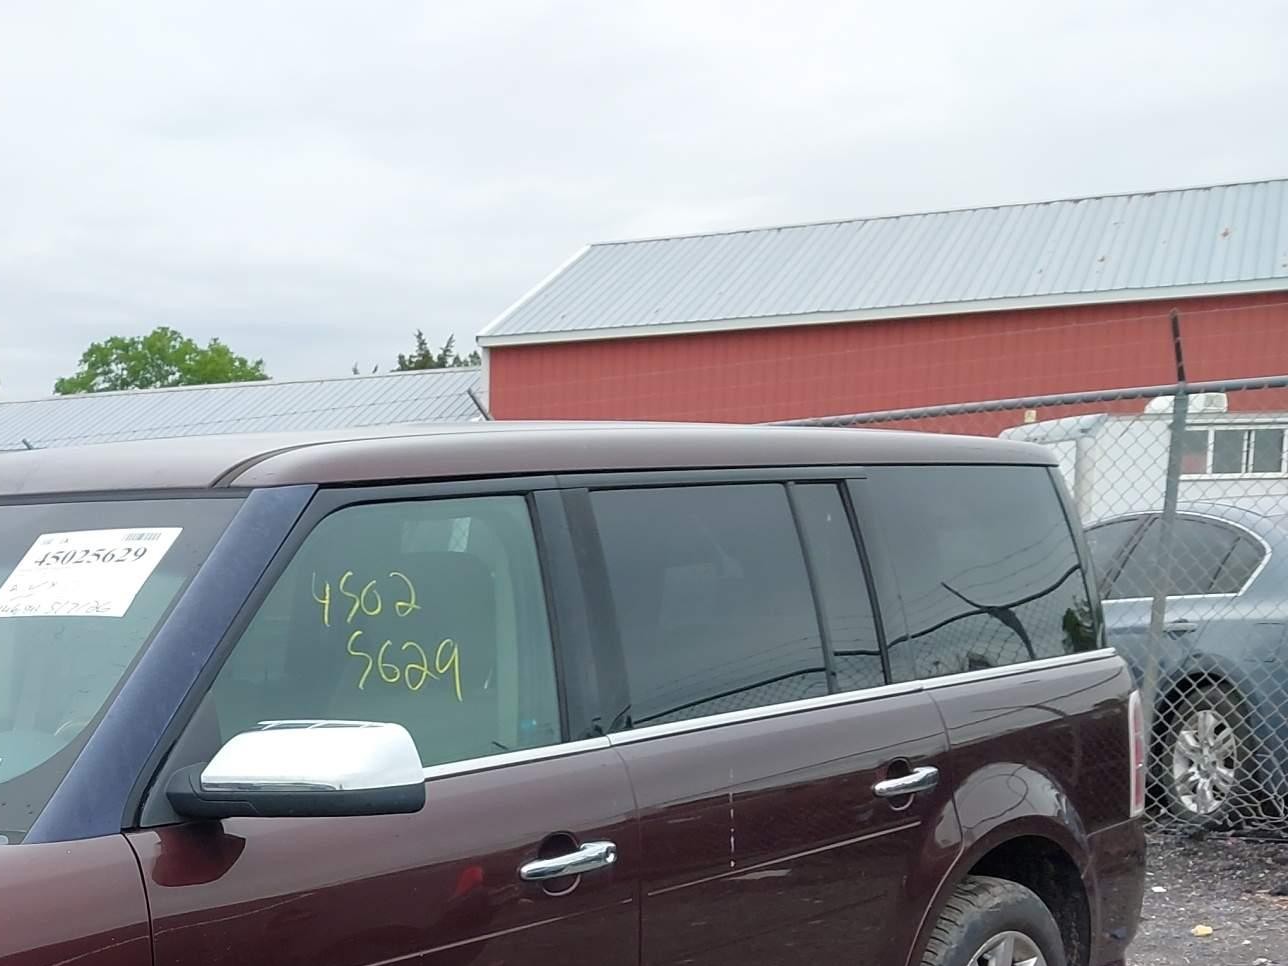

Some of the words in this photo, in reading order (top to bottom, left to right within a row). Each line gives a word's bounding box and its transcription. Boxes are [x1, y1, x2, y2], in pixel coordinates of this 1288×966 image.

[34, 547, 148, 567] 45025629
[312, 571, 422, 628] 4502
[346, 630, 463, 702] 5629
